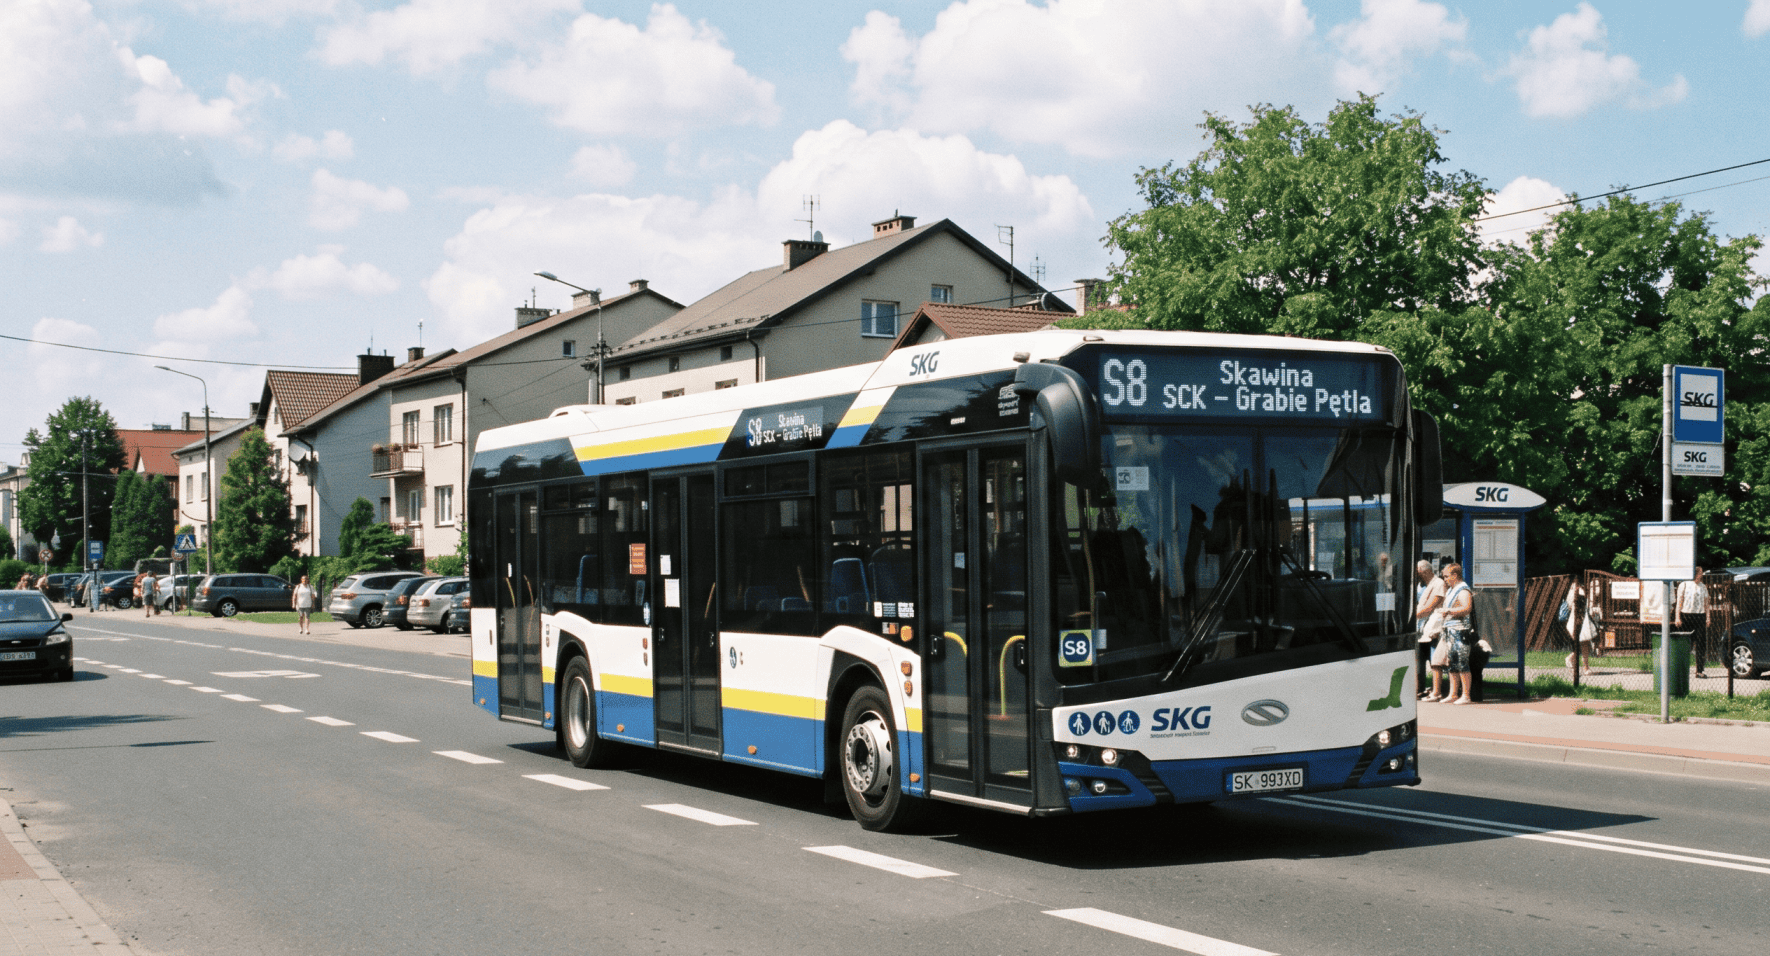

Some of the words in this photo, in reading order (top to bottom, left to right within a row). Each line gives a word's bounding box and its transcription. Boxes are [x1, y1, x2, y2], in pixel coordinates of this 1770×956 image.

[909, 350, 940, 377] SKG
[1219, 360, 1313, 387] Skawina
[1103, 358, 1147, 406] S8
[1162, 383, 1207, 409] SCK
[1236, 386, 1307, 411] Grabie
[1315, 388, 1372, 418] Pętla
[1684, 391, 1715, 408] SKG
[748, 417, 762, 447] S8
[1684, 450, 1707, 463] SKG
[1475, 486, 1509, 503] SKG
[1064, 640, 1087, 656] S8
[1151, 705, 1212, 732] SKG
[1234, 773, 1253, 790] SK
[1260, 771, 1301, 788] 993XD
